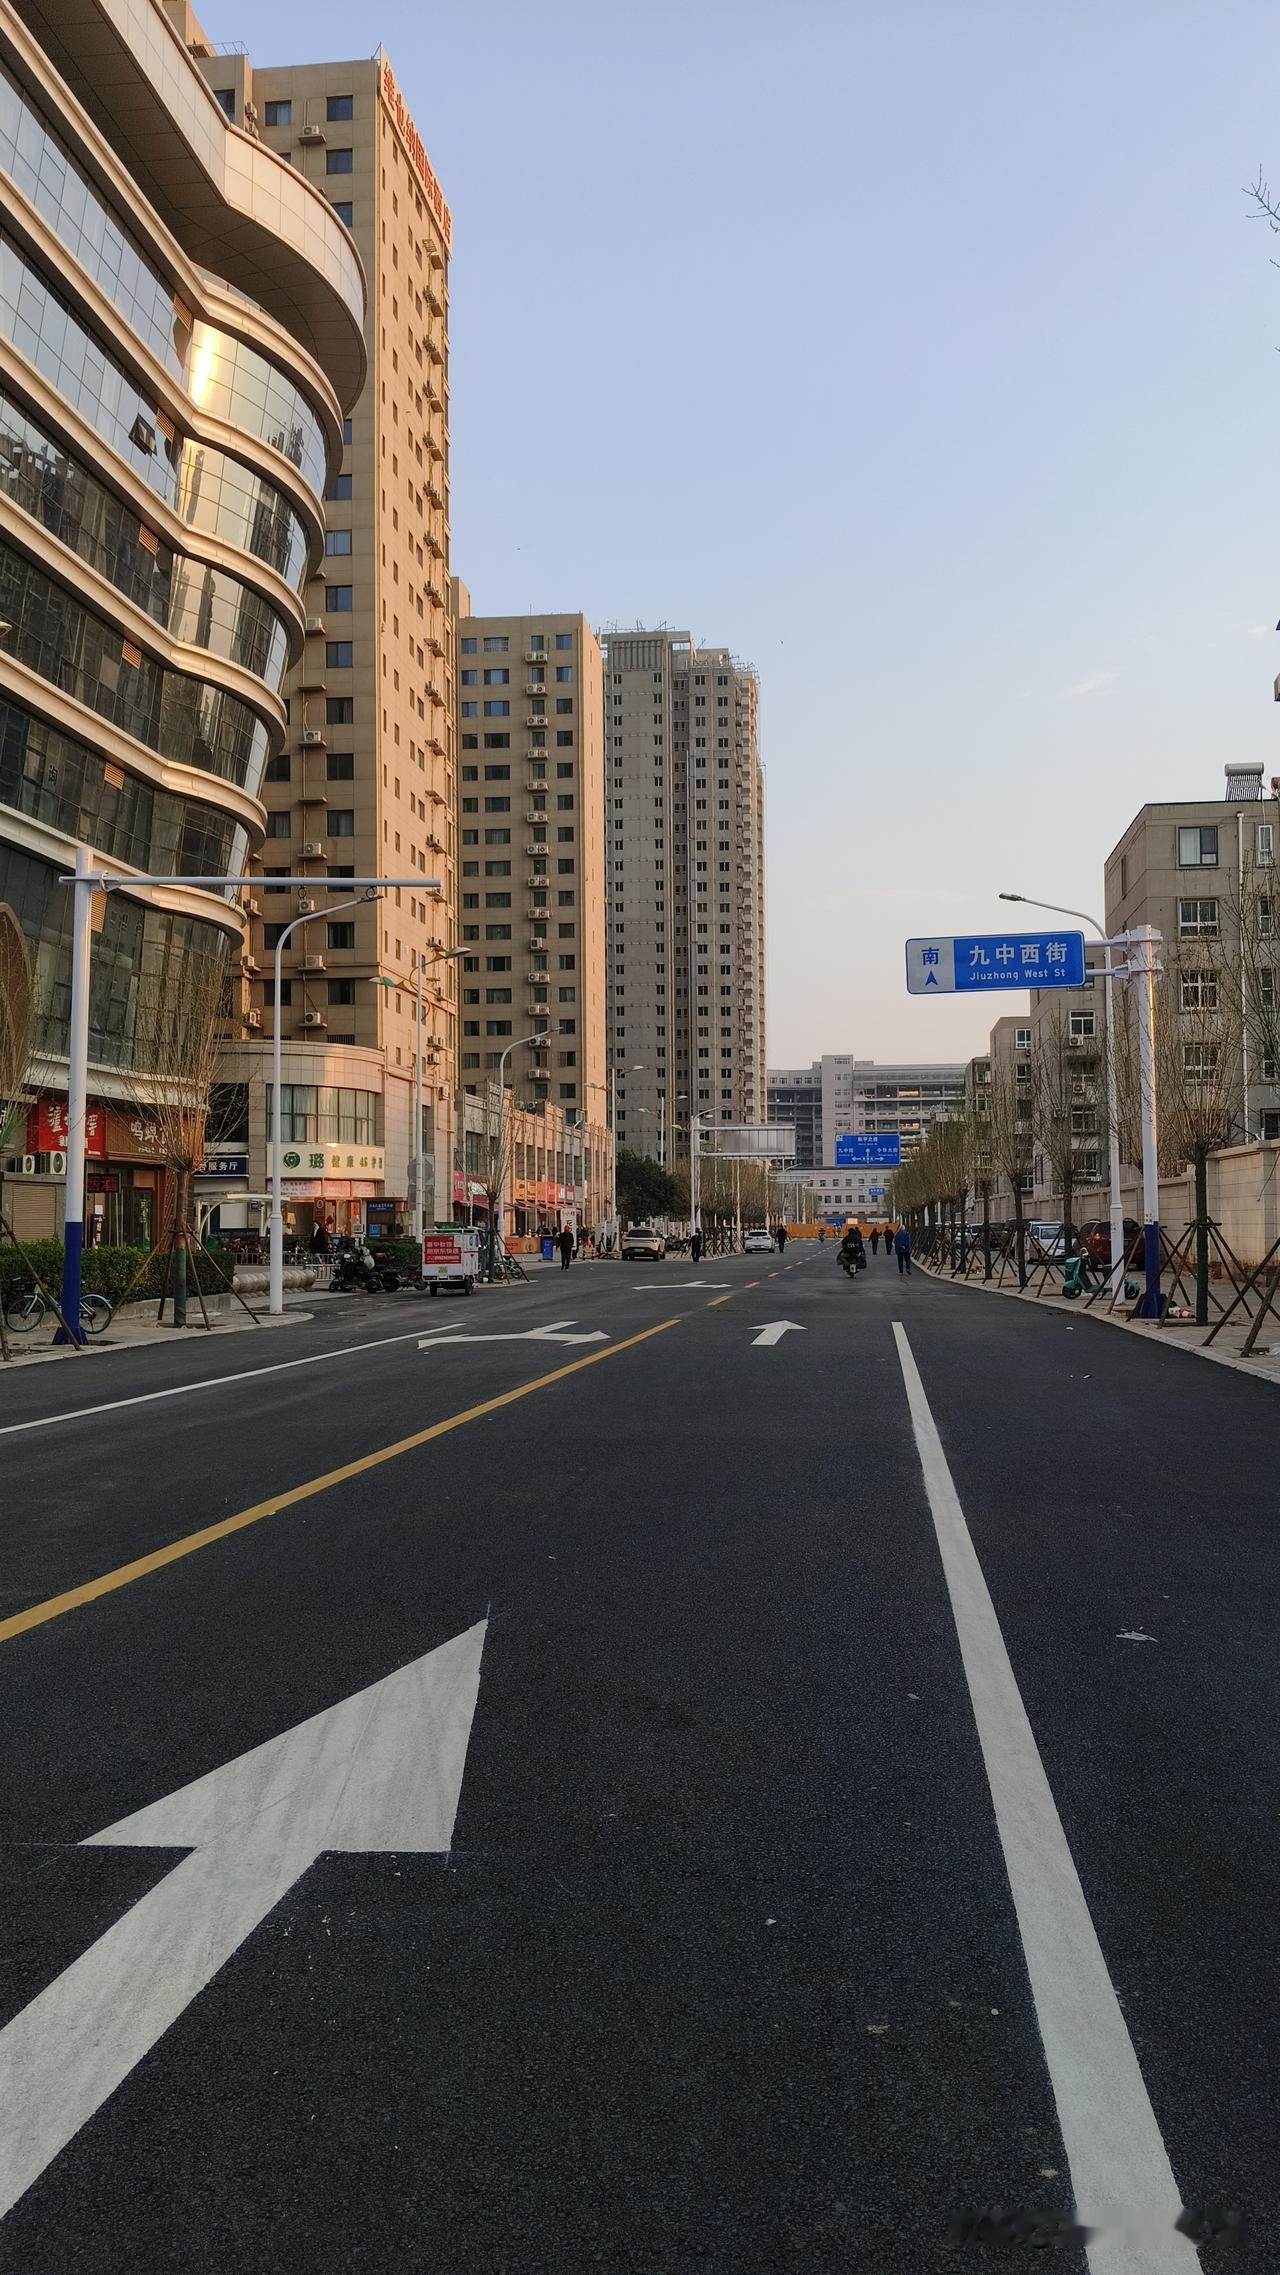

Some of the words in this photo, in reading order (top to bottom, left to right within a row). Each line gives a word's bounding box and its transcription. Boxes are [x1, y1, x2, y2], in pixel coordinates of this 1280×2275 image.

[383, 61, 452, 244] 维也纳国际酒店
[920, 946, 940, 966] 南
[969, 942, 1068, 967] 九中西街
[969, 971, 1019, 981] Jiuzhong
[1024, 969, 1049, 978] West
[1054, 968, 1066, 977] St
